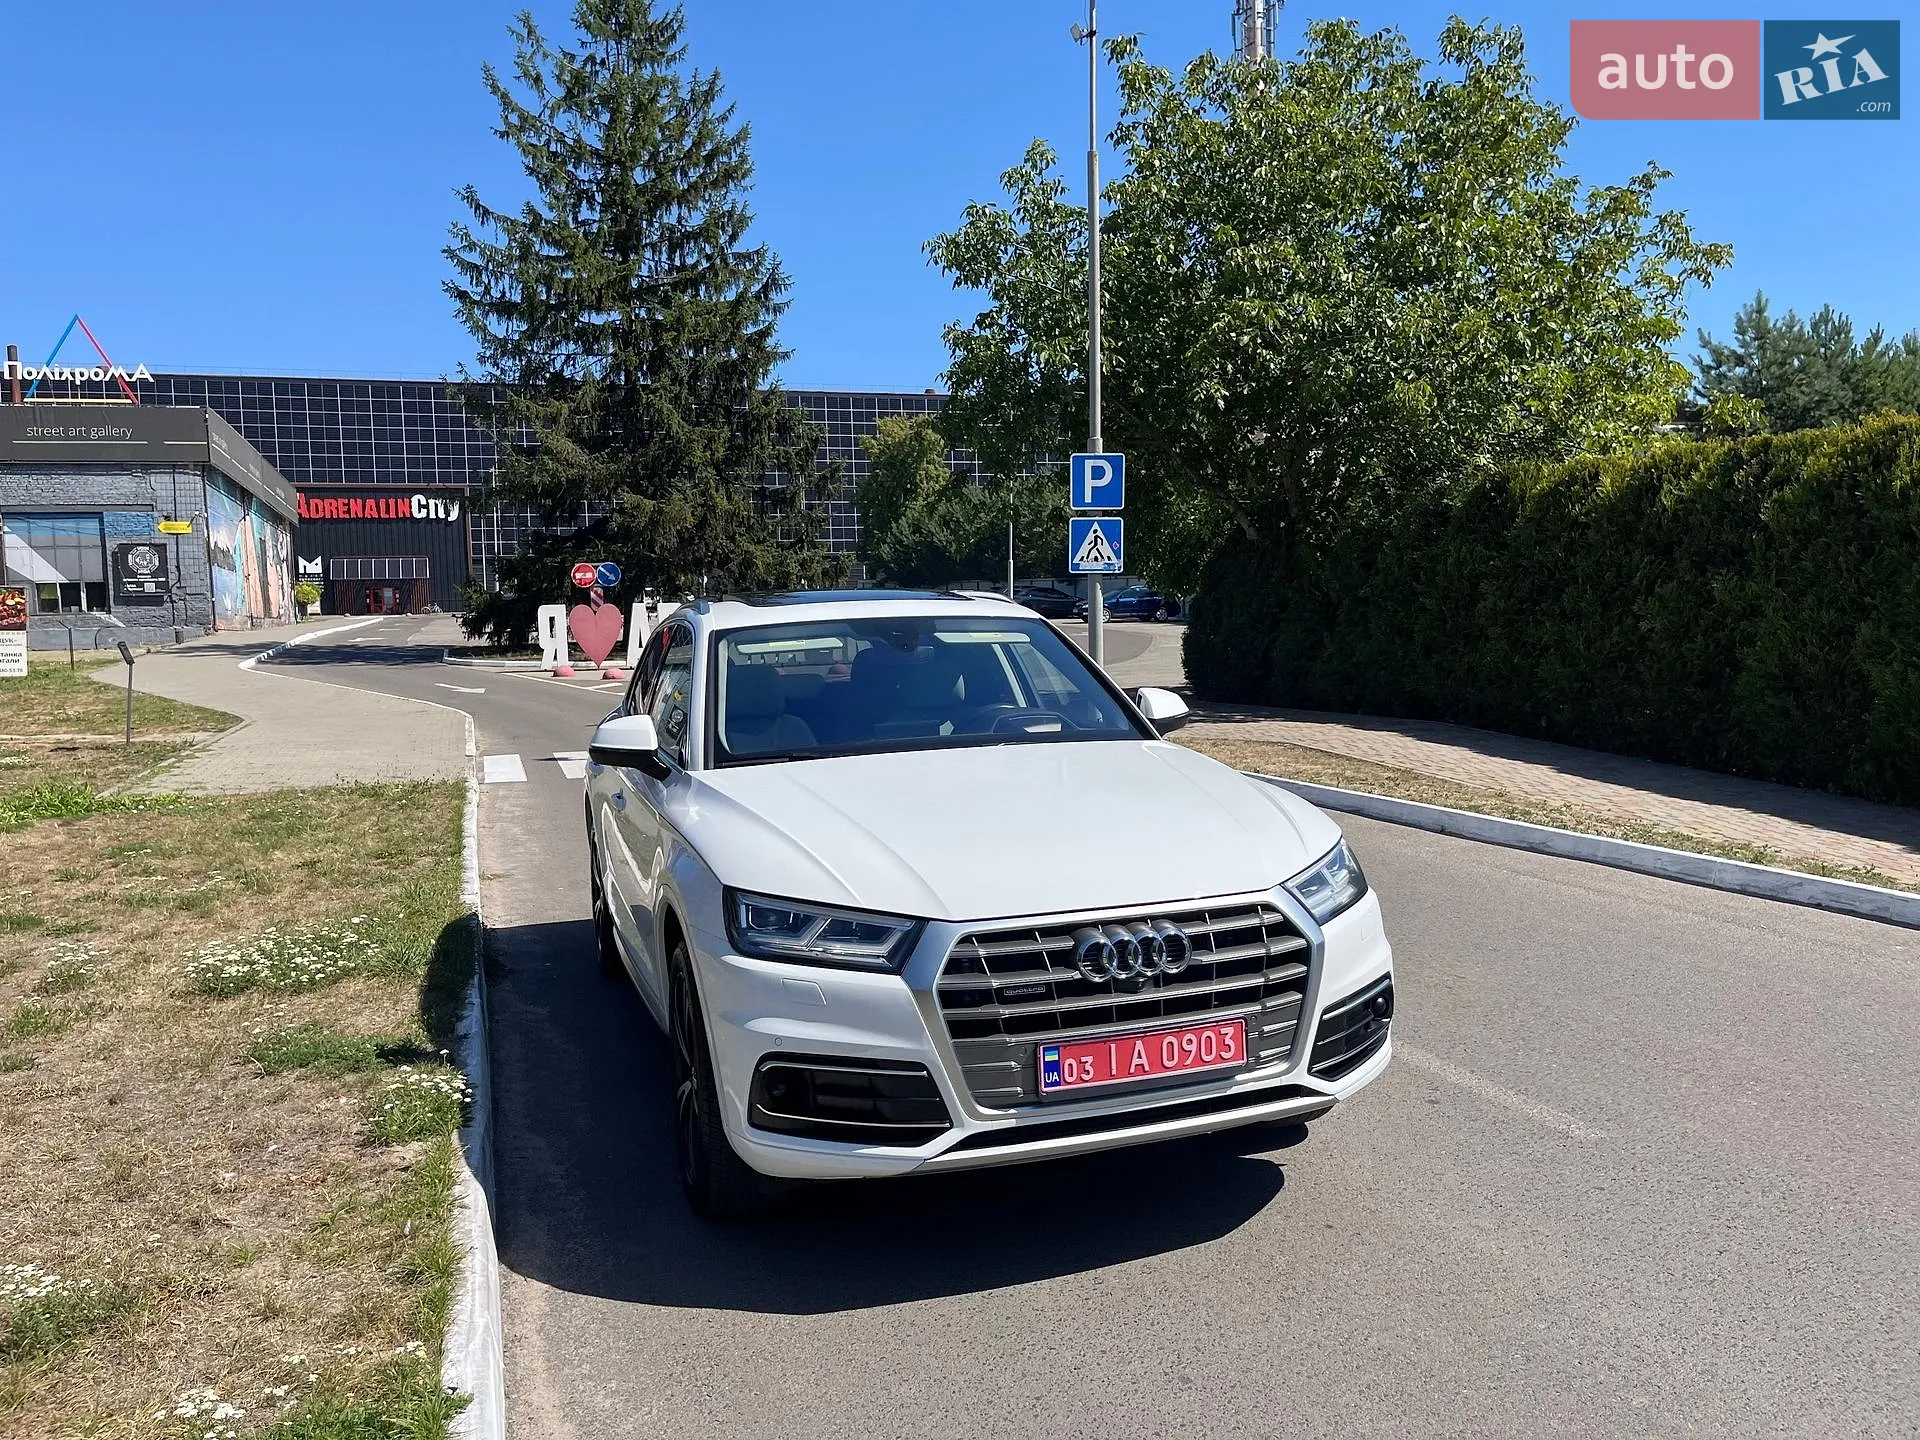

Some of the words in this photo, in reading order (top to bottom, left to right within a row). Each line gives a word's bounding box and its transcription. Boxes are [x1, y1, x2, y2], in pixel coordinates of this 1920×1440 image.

[26, 425, 65, 437] street
[69, 426, 87, 437] art
[90, 425, 133, 440] gallery
[1084, 459, 1113, 503] P
[1006, 985, 1044, 994] quattro
[1063, 1056, 1095, 1084] 03
[1161, 1026, 1236, 1069] 0903
[1045, 1072, 1060, 1084] UA
